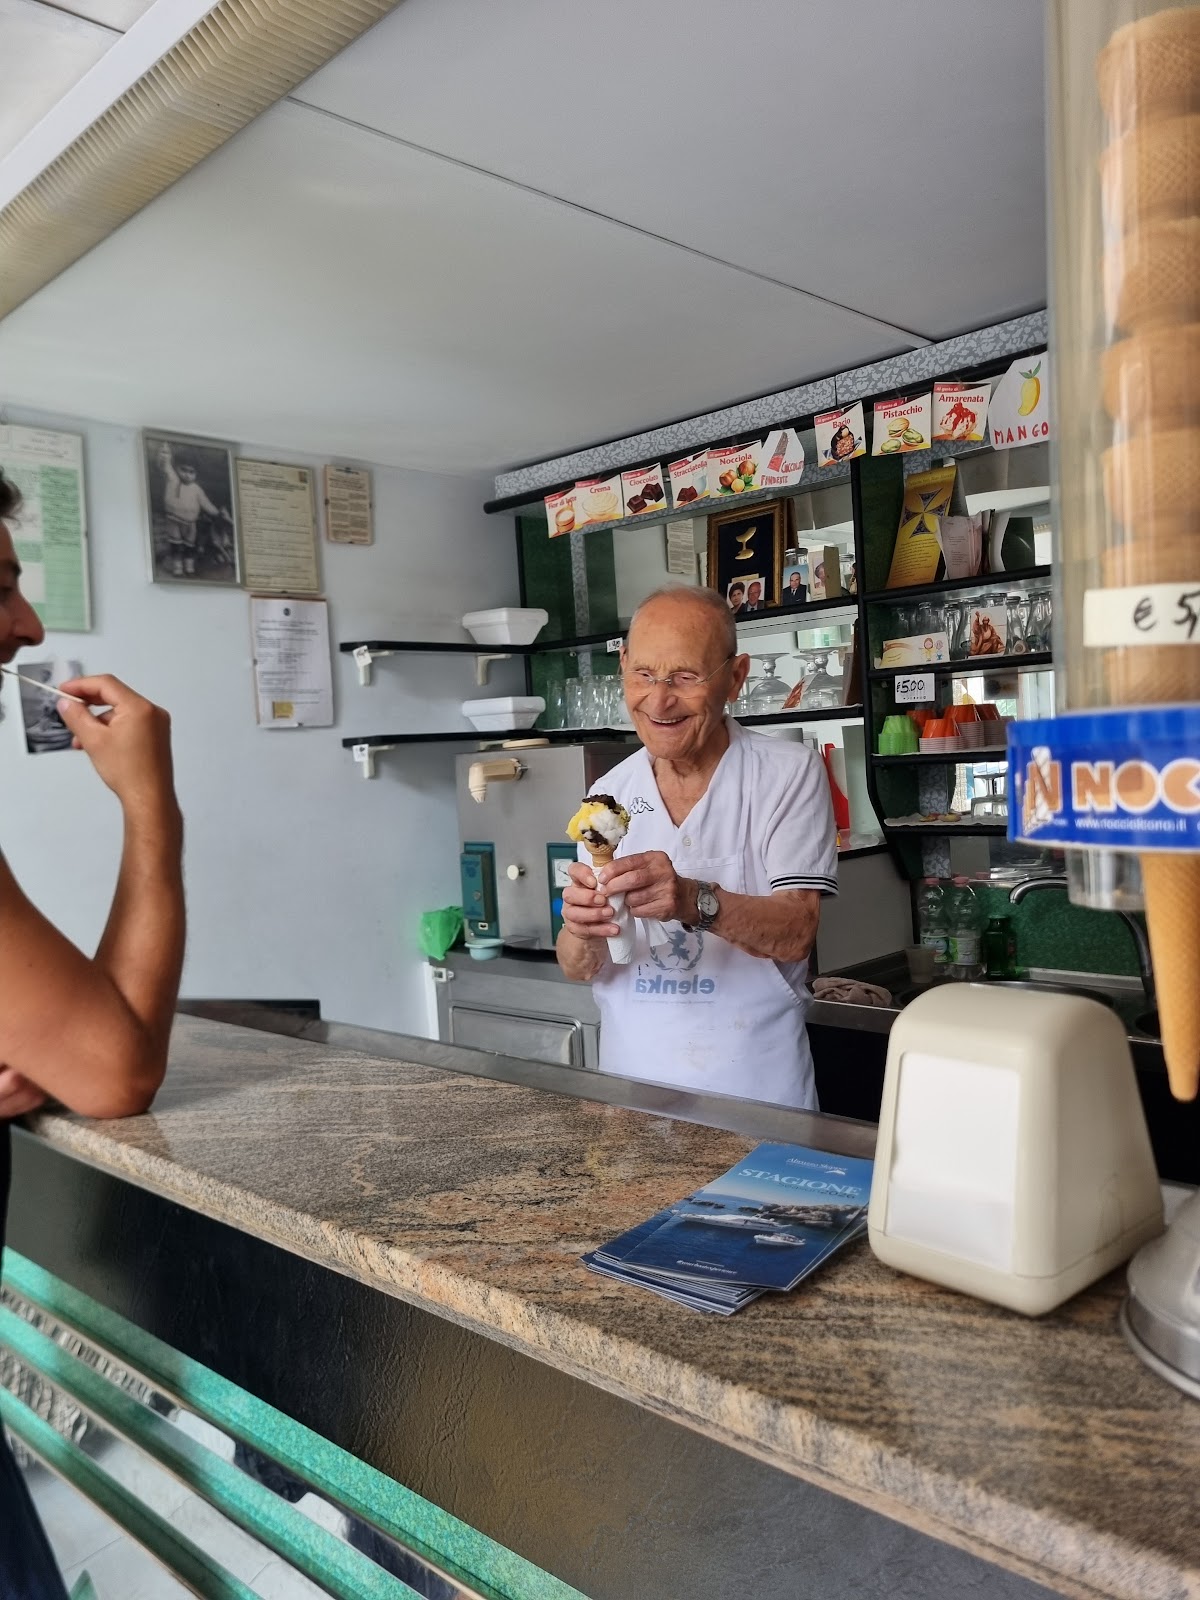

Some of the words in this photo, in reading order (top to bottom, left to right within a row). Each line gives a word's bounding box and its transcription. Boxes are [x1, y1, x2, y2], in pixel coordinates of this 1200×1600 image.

[939, 394, 984, 403] Amarenata
[883, 405, 923, 419] Pistacchio
[833, 418, 850, 429] Bacio
[993, 422, 1049, 444] MANGO
[719, 453, 752, 466] Nocciola
[673, 460, 708, 478] Stracciatella
[629, 474, 659, 486] Cioccolato
[589, 485, 611, 494] Crema
[738, 1168, 862, 1196] STAGIONE
